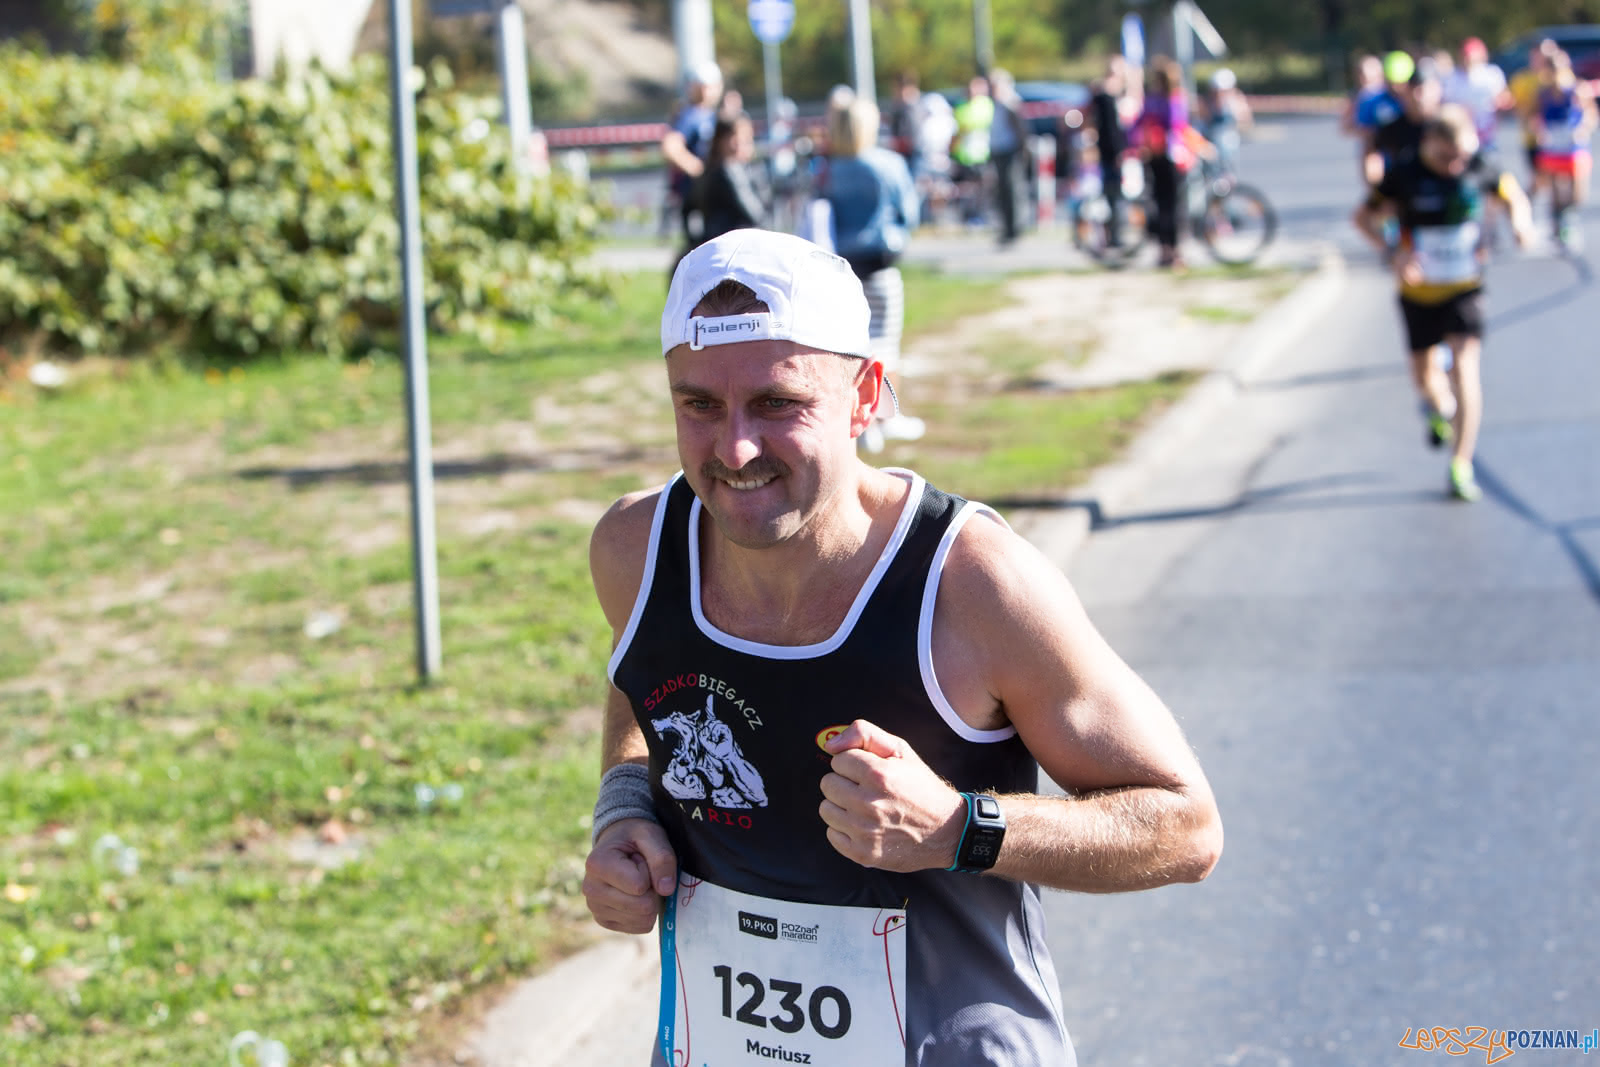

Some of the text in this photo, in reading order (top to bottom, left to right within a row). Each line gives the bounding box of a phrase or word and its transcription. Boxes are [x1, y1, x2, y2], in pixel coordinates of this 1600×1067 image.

[754, 920, 775, 933] PKO
[781, 930, 818, 941] maraton
[713, 965, 852, 1039] 1230
[746, 1038, 811, 1064] Mariusz
